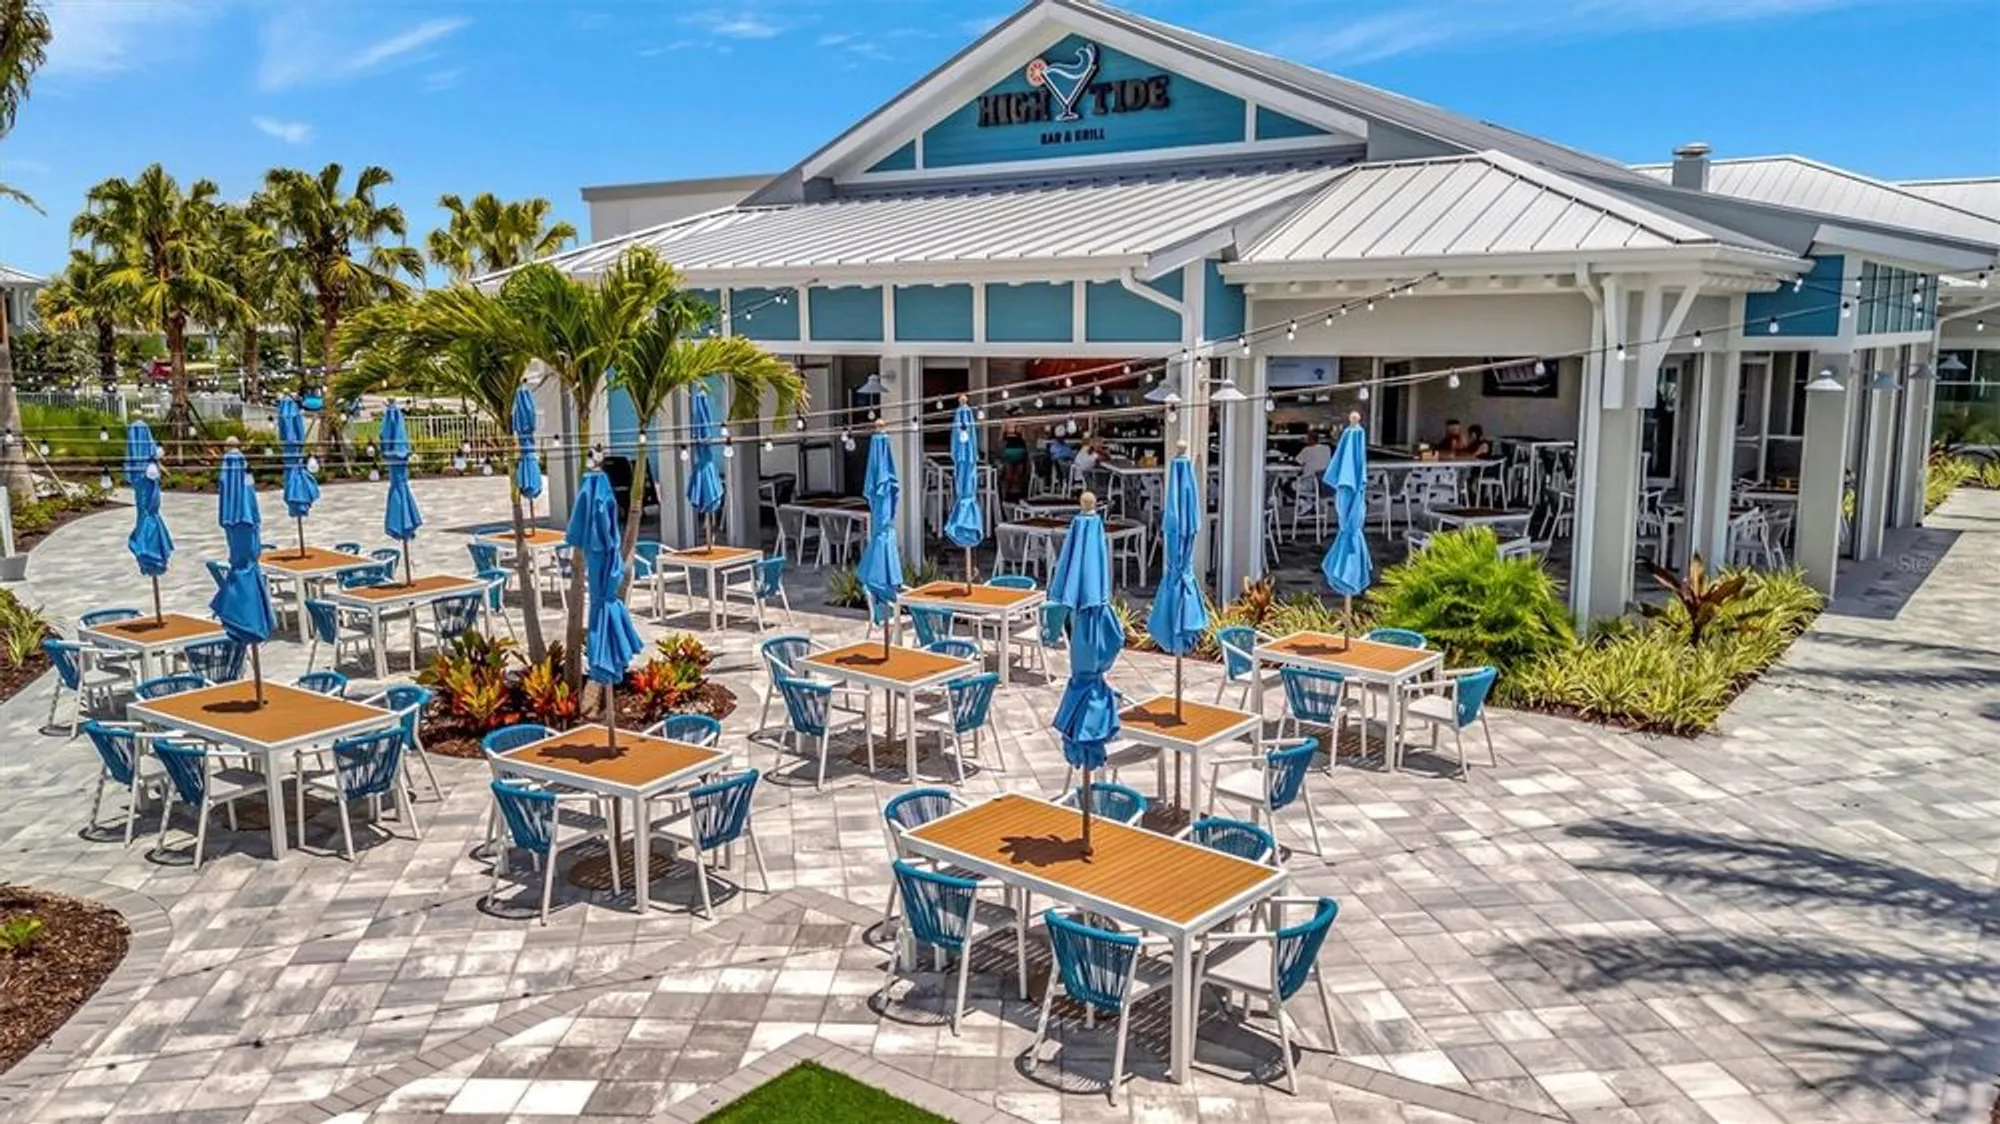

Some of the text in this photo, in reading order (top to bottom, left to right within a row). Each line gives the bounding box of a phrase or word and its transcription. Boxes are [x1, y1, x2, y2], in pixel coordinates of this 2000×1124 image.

[978, 75, 1170, 127] HIGH TIDE
[1041, 132, 1061, 145] BAR
[1075, 128, 1105, 141] GRILL
